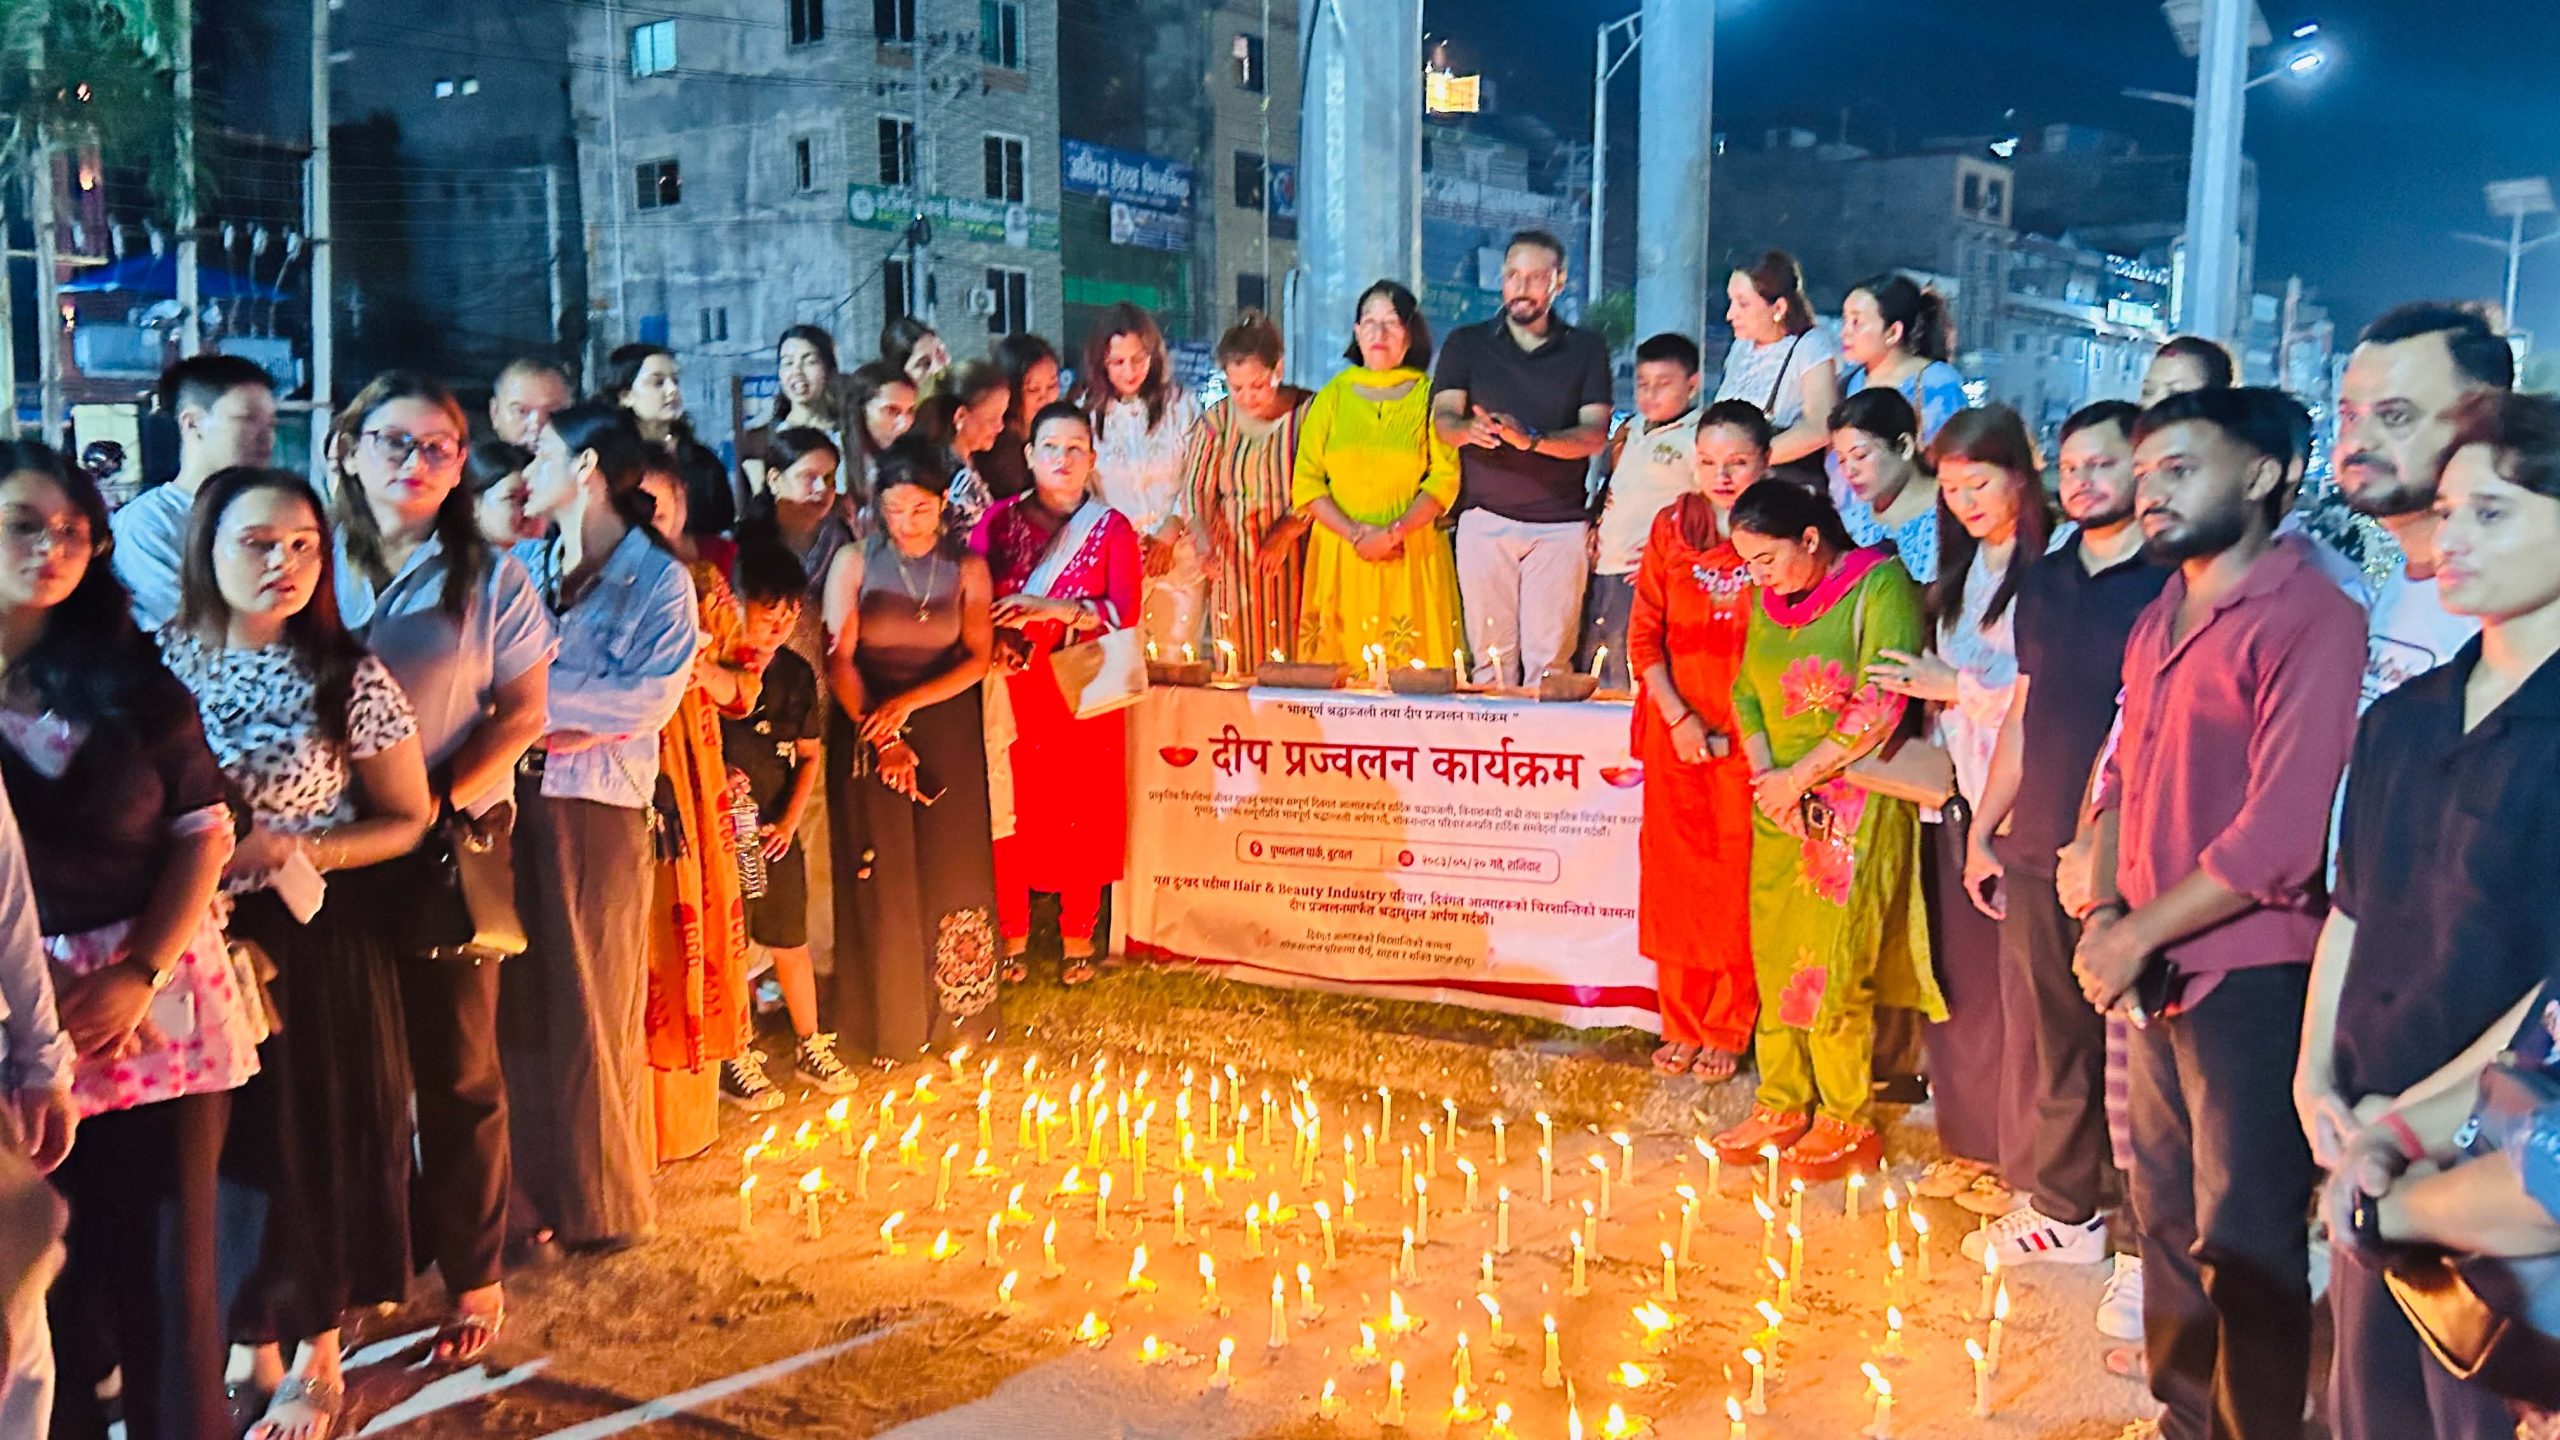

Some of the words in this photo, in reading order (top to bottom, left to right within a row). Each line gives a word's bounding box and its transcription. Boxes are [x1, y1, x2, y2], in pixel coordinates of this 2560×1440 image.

[1288, 703, 1323, 719] भावपूर्ण
[1381, 707, 1400, 719] तथा
[1404, 705, 1421, 721] दीप
[1424, 709, 1463, 722] प्रज्वलन
[1467, 708, 1507, 723] कार्यक्रम
[1208, 724, 1273, 777] दीप
[1282, 739, 1419, 782] प्रज्वलन
[1429, 737, 1585, 790] कार्यक्रम
[1307, 845, 1325, 860] पार्क,
[1327, 848, 1353, 862] बुटवल
[1233, 879, 1262, 893] Hair
[1265, 882, 1274, 894] &
[1278, 883, 1324, 900] Beauty
[1328, 886, 1387, 904] Industry
[1390, 888, 1427, 906] परिवार,
[1431, 891, 1464, 907] दिवंगत
[1531, 898, 1595, 917] चिरशान्तिको
[1599, 904, 1635, 919] कामना
[1309, 899, 1375, 915] प्रज्वलनमार्फत
[1379, 905, 1427, 922] श्रद्धासुमन
[1430, 907, 1458, 923] अर्पण
